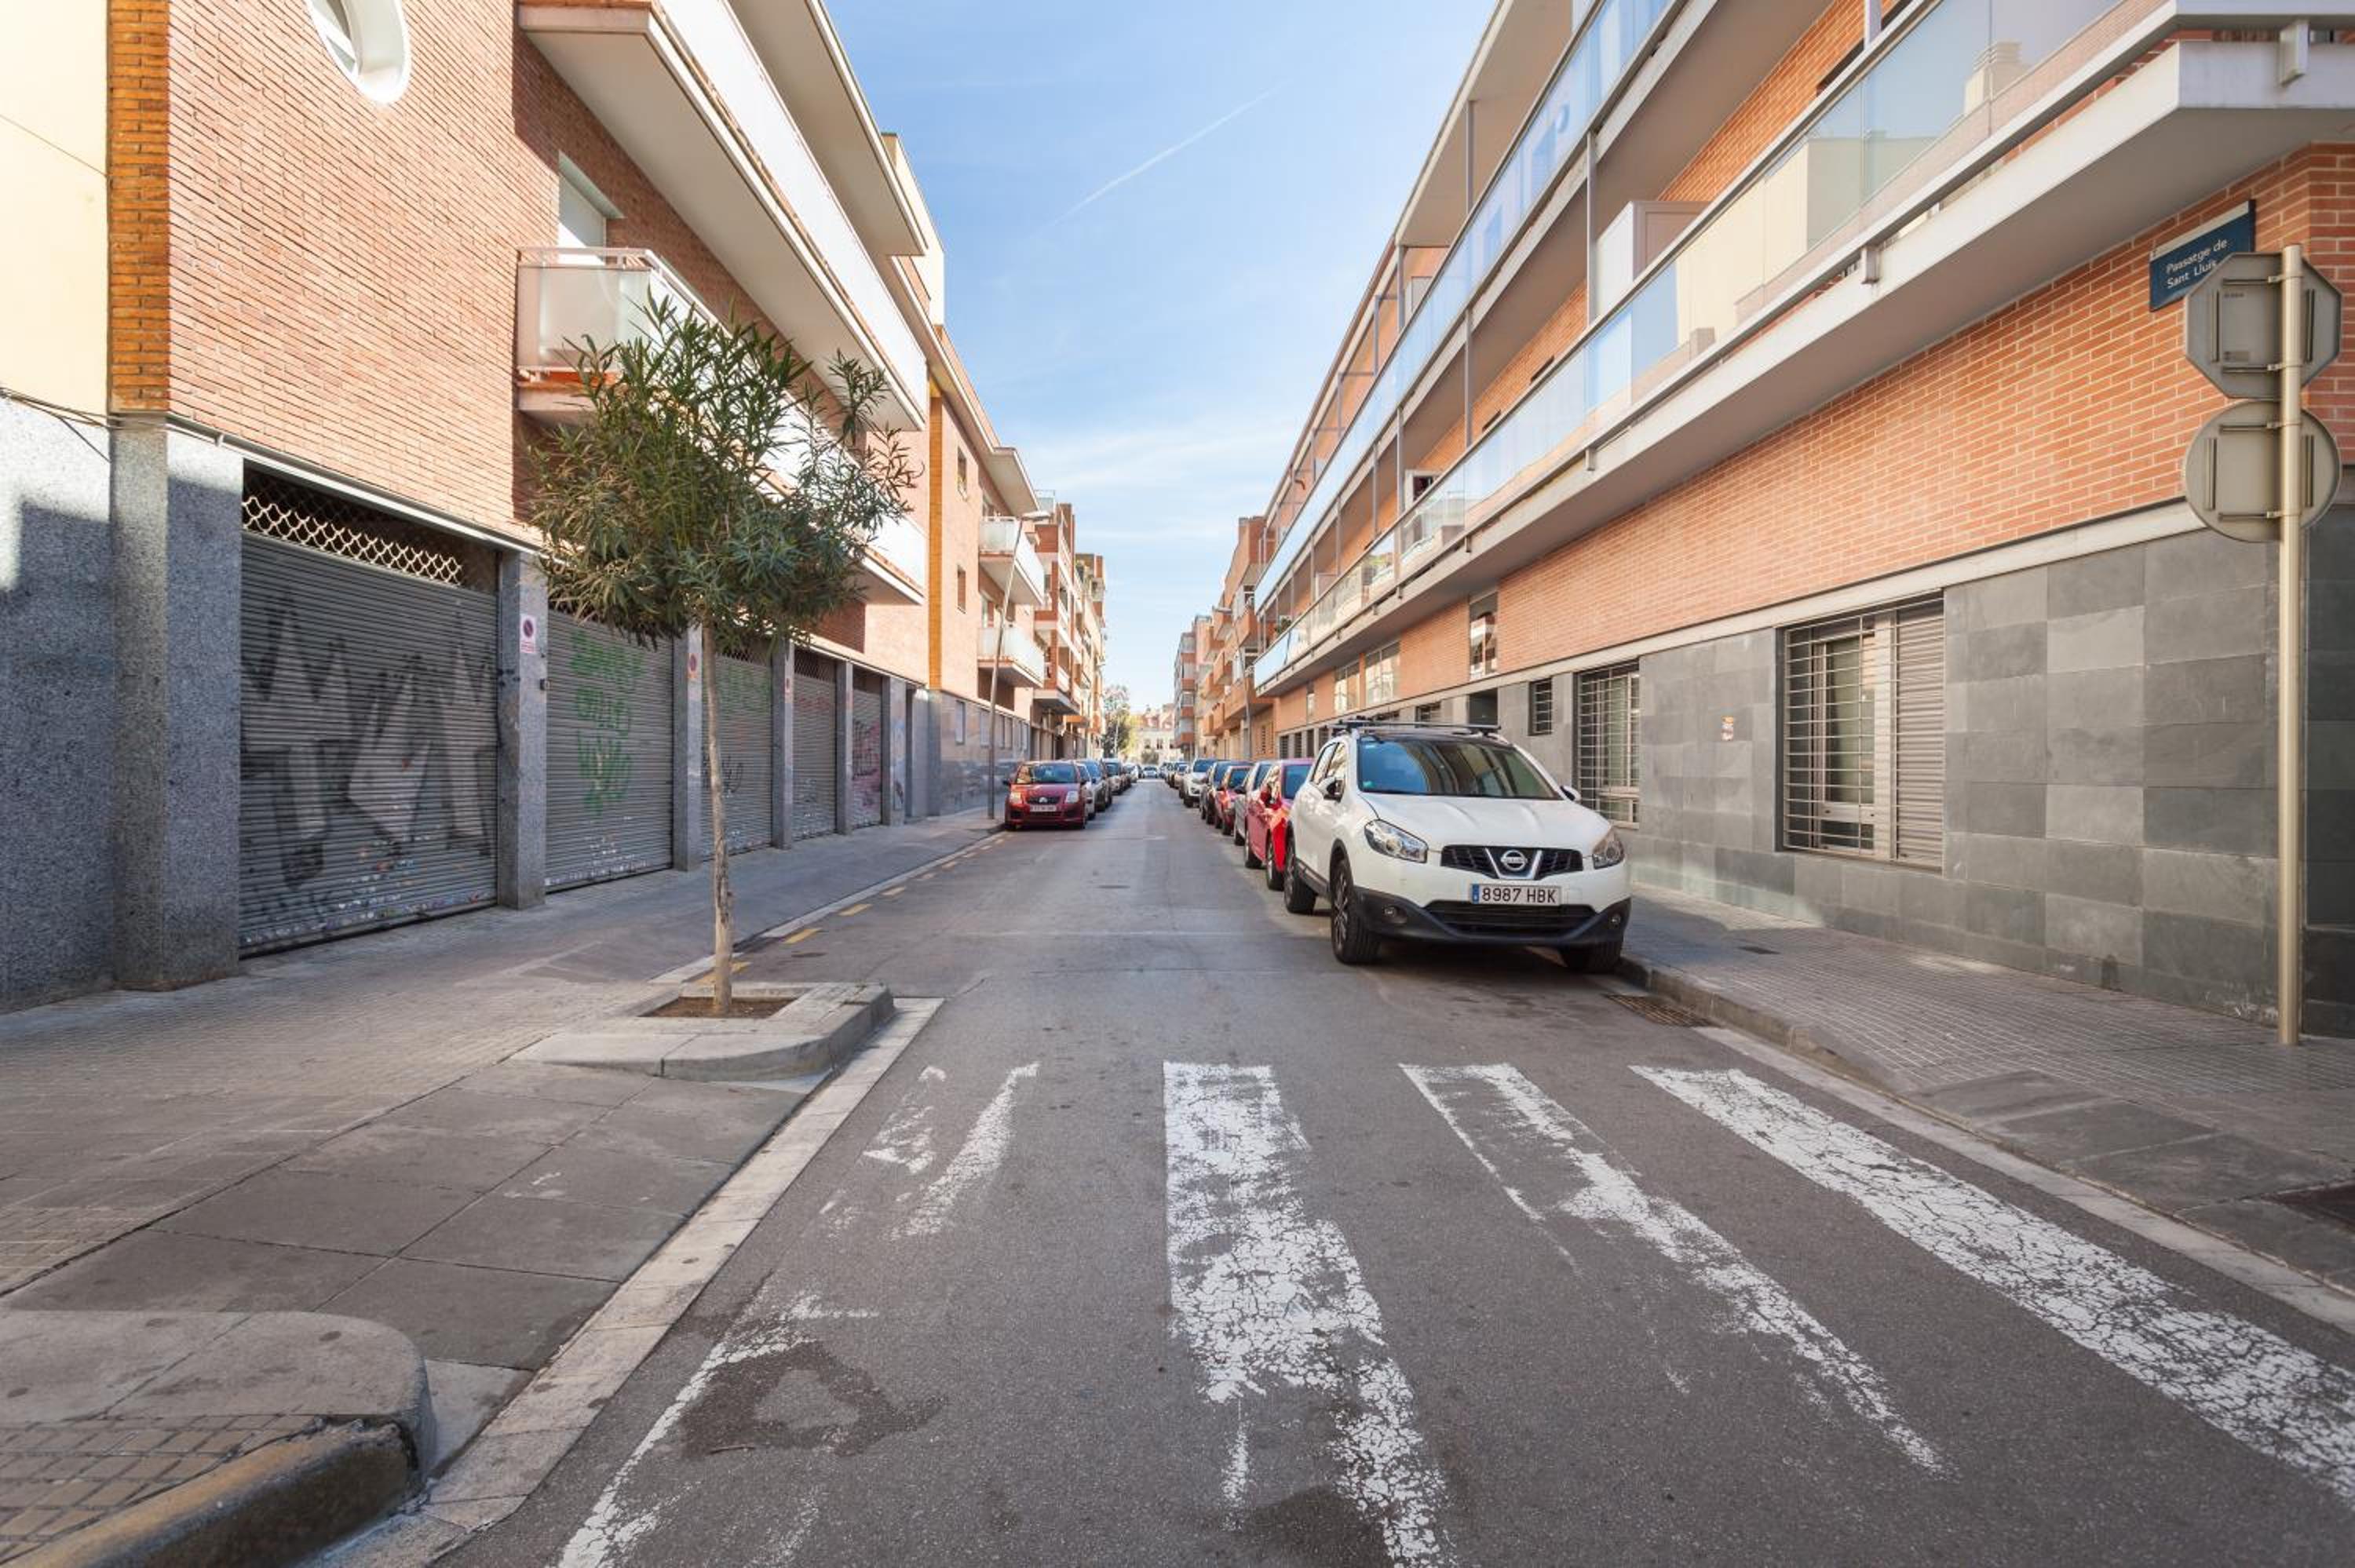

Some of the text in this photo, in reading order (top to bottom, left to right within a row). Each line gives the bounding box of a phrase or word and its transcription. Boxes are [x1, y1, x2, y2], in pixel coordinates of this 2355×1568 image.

[2213, 239, 2228, 252] de
[2167, 272, 2189, 289] Sant
[1481, 888, 1556, 903] 8987 HBK
